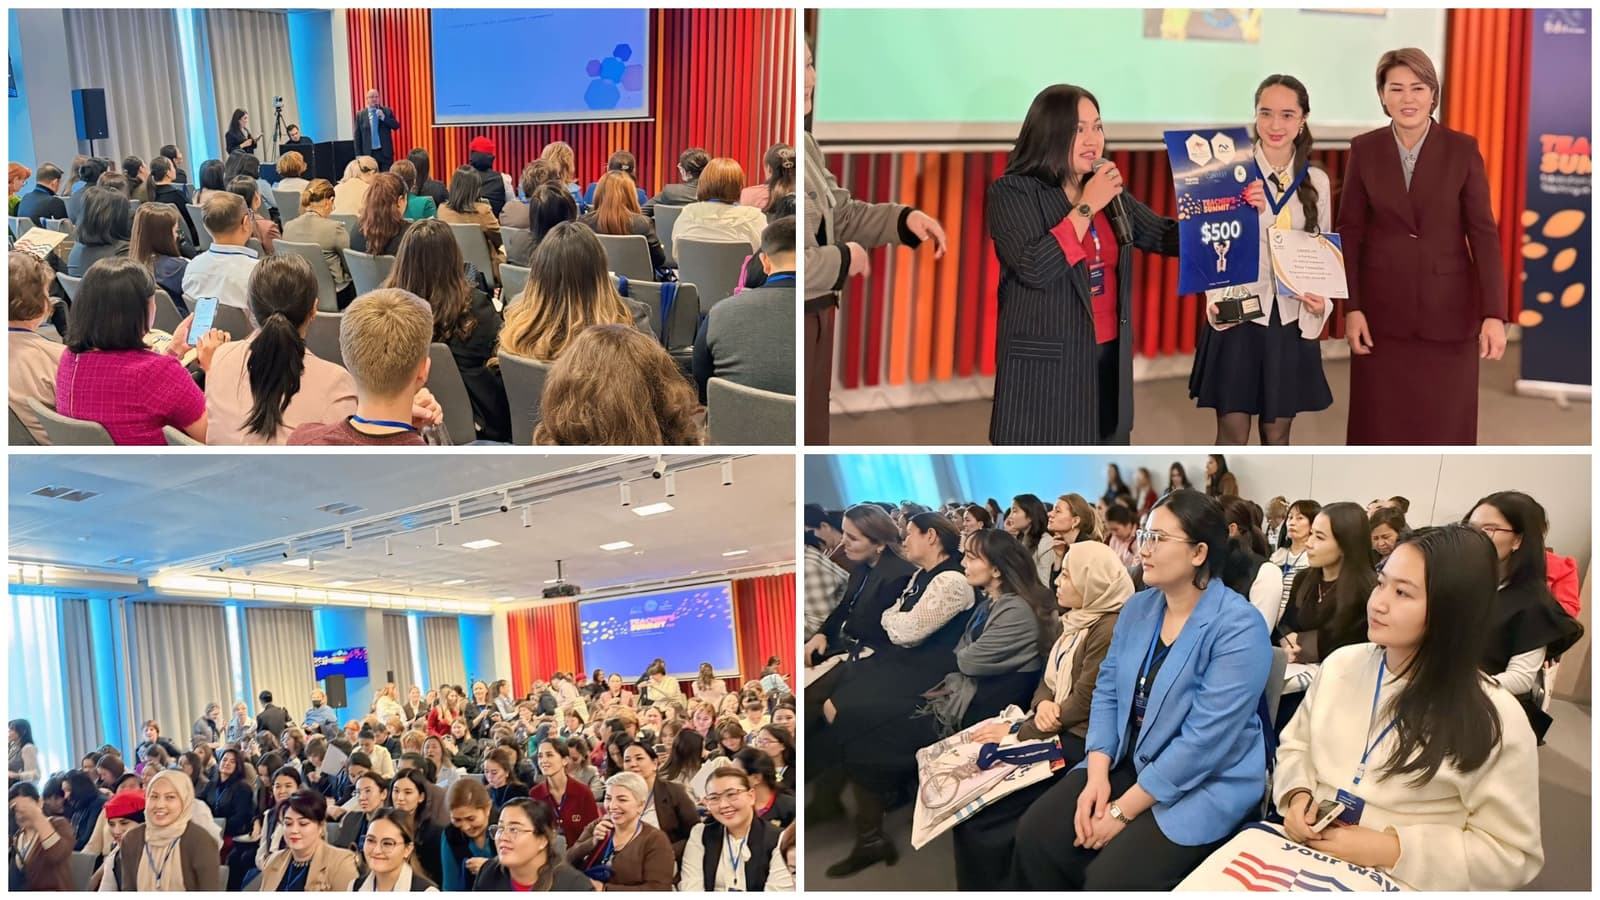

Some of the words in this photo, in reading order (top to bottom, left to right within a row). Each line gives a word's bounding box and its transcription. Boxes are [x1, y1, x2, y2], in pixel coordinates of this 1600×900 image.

[1203, 203, 1230, 213] SUMMIT
[1201, 220, 1241, 244] $500
[1281, 842, 1341, 865] your
